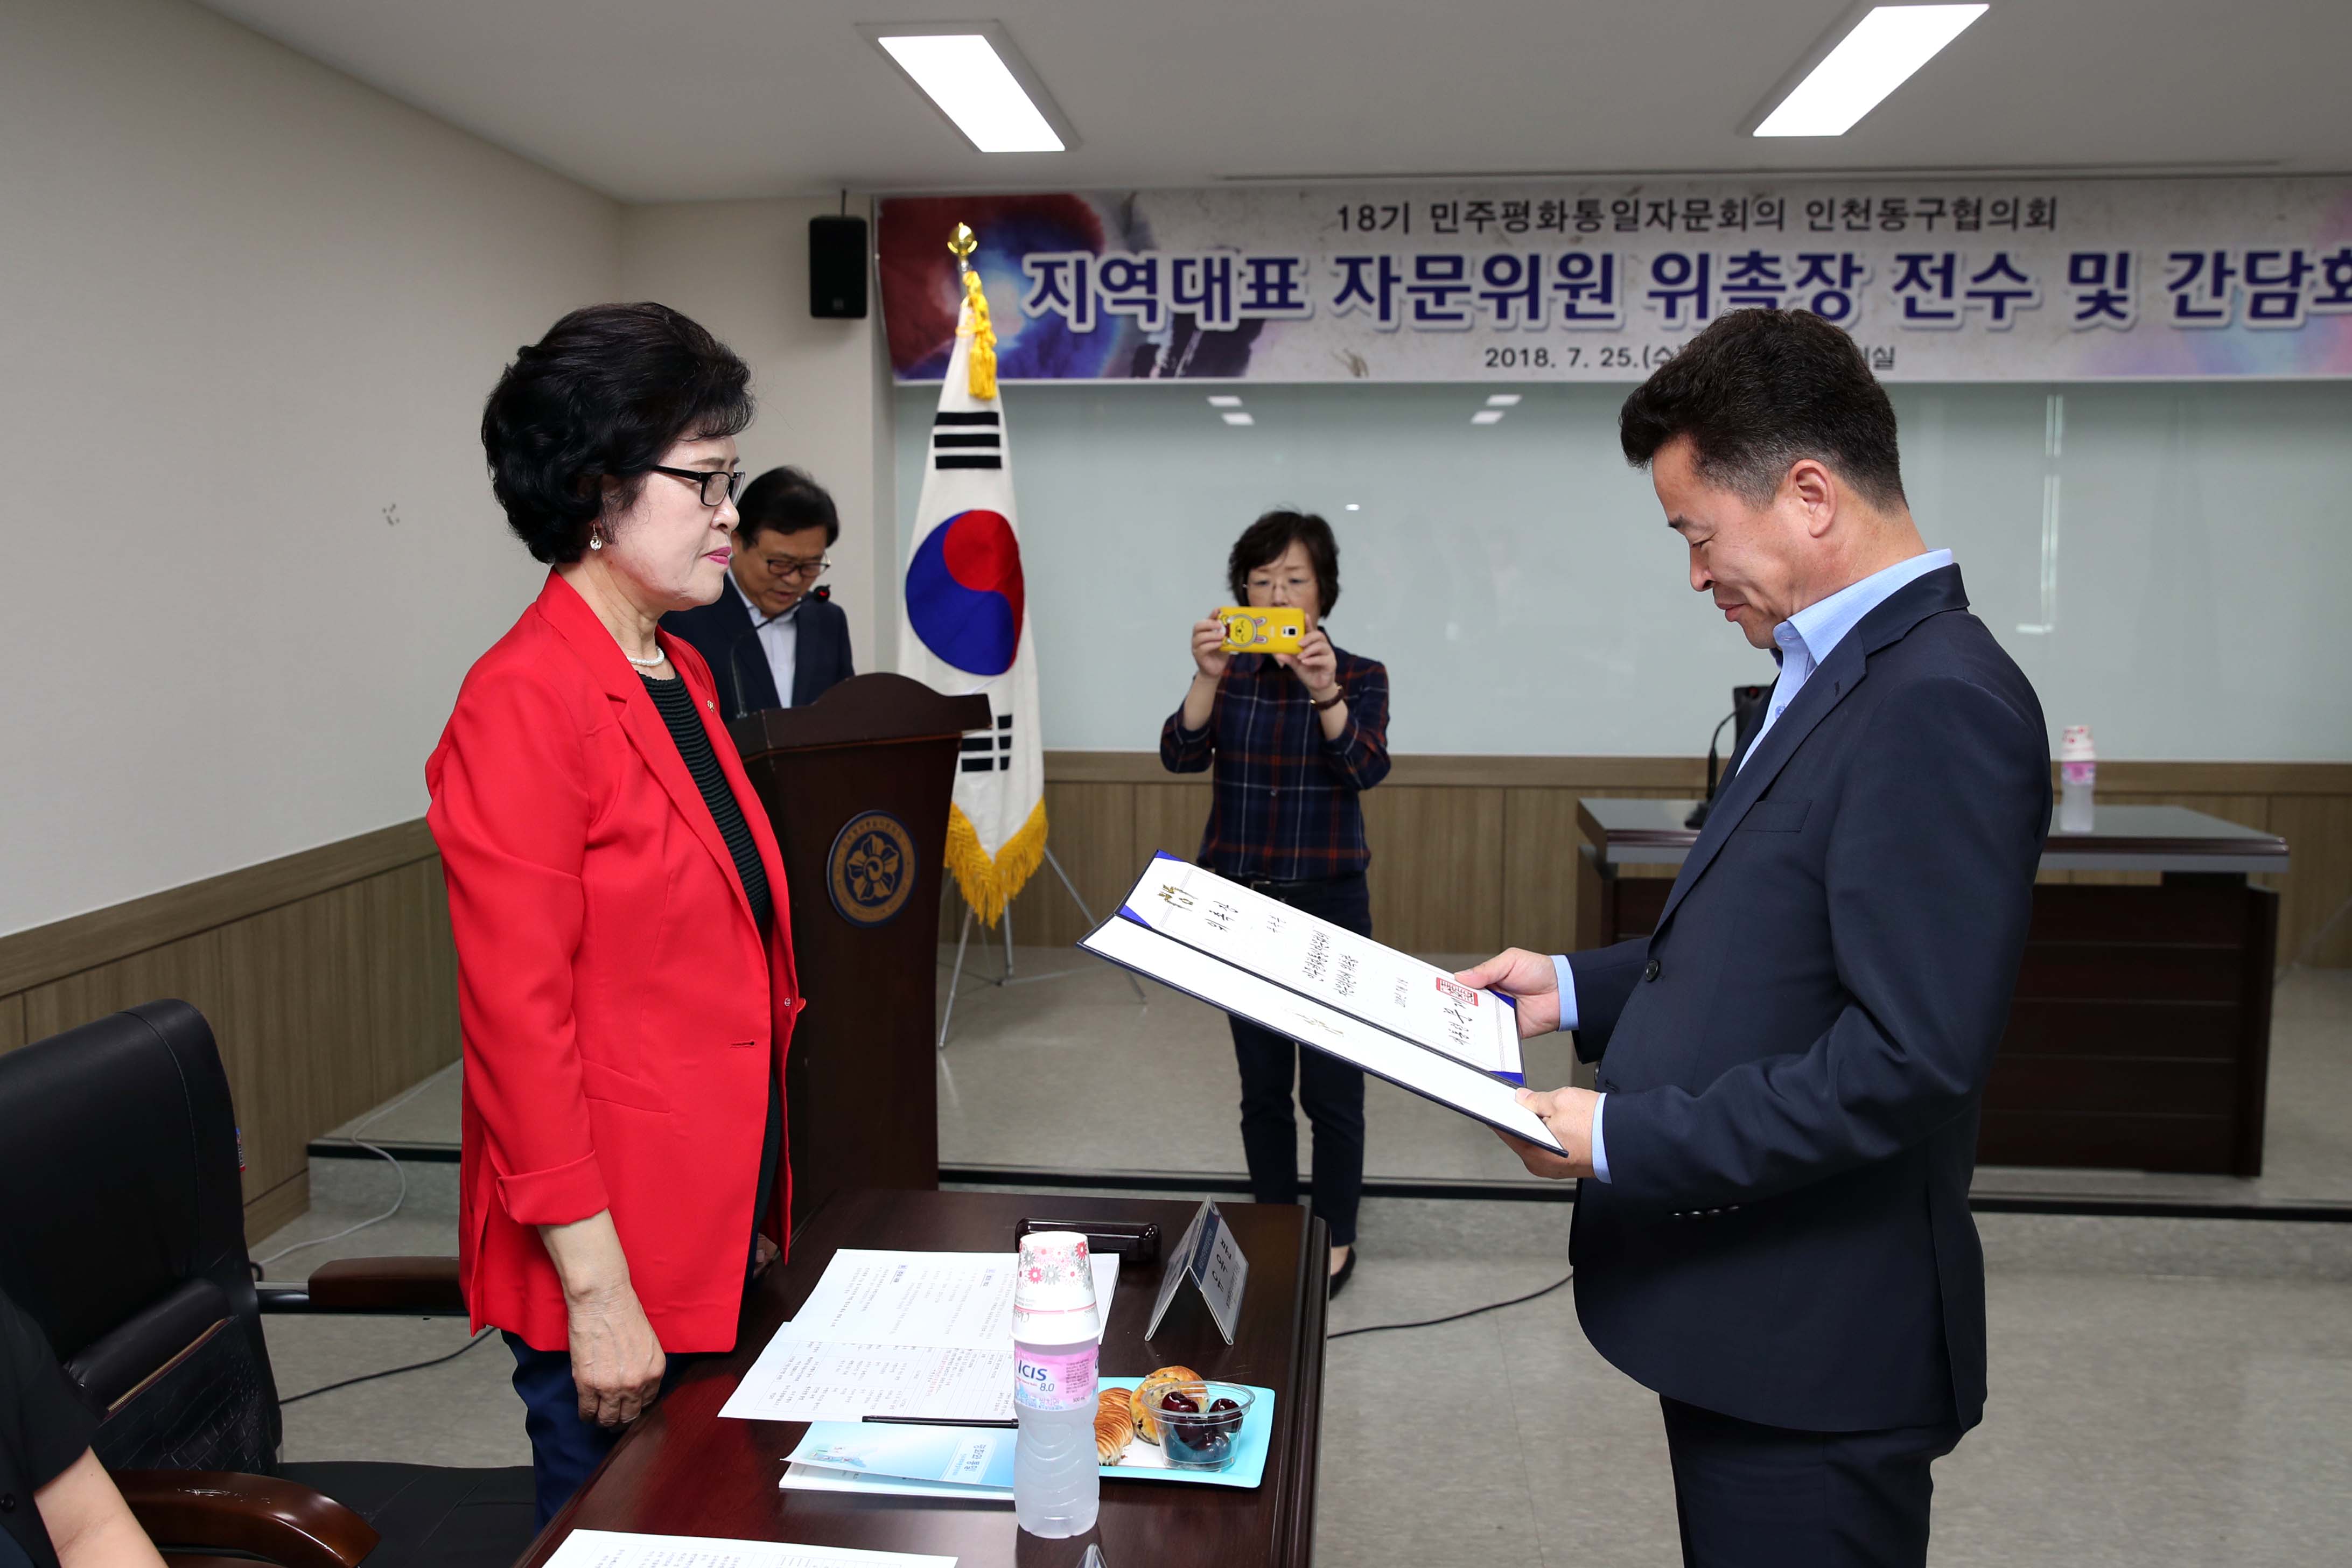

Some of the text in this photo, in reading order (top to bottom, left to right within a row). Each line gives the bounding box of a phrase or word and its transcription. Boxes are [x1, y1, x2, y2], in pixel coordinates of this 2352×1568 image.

[1338, 197, 2057, 234] 18기 민주평화통일자문회의 인천동구협의회
[1030, 256, 1304, 324] 지역대표
[1333, 251, 1615, 322] 자문위원
[1648, 250, 1863, 321] 위촉장
[1892, 251, 2033, 320] 전수
[2069, 250, 2130, 320] 및
[1486, 347, 1556, 368] 2018.
[1568, 347, 1588, 368] 7.
[1040, 1383, 1055, 1392] 8.0
